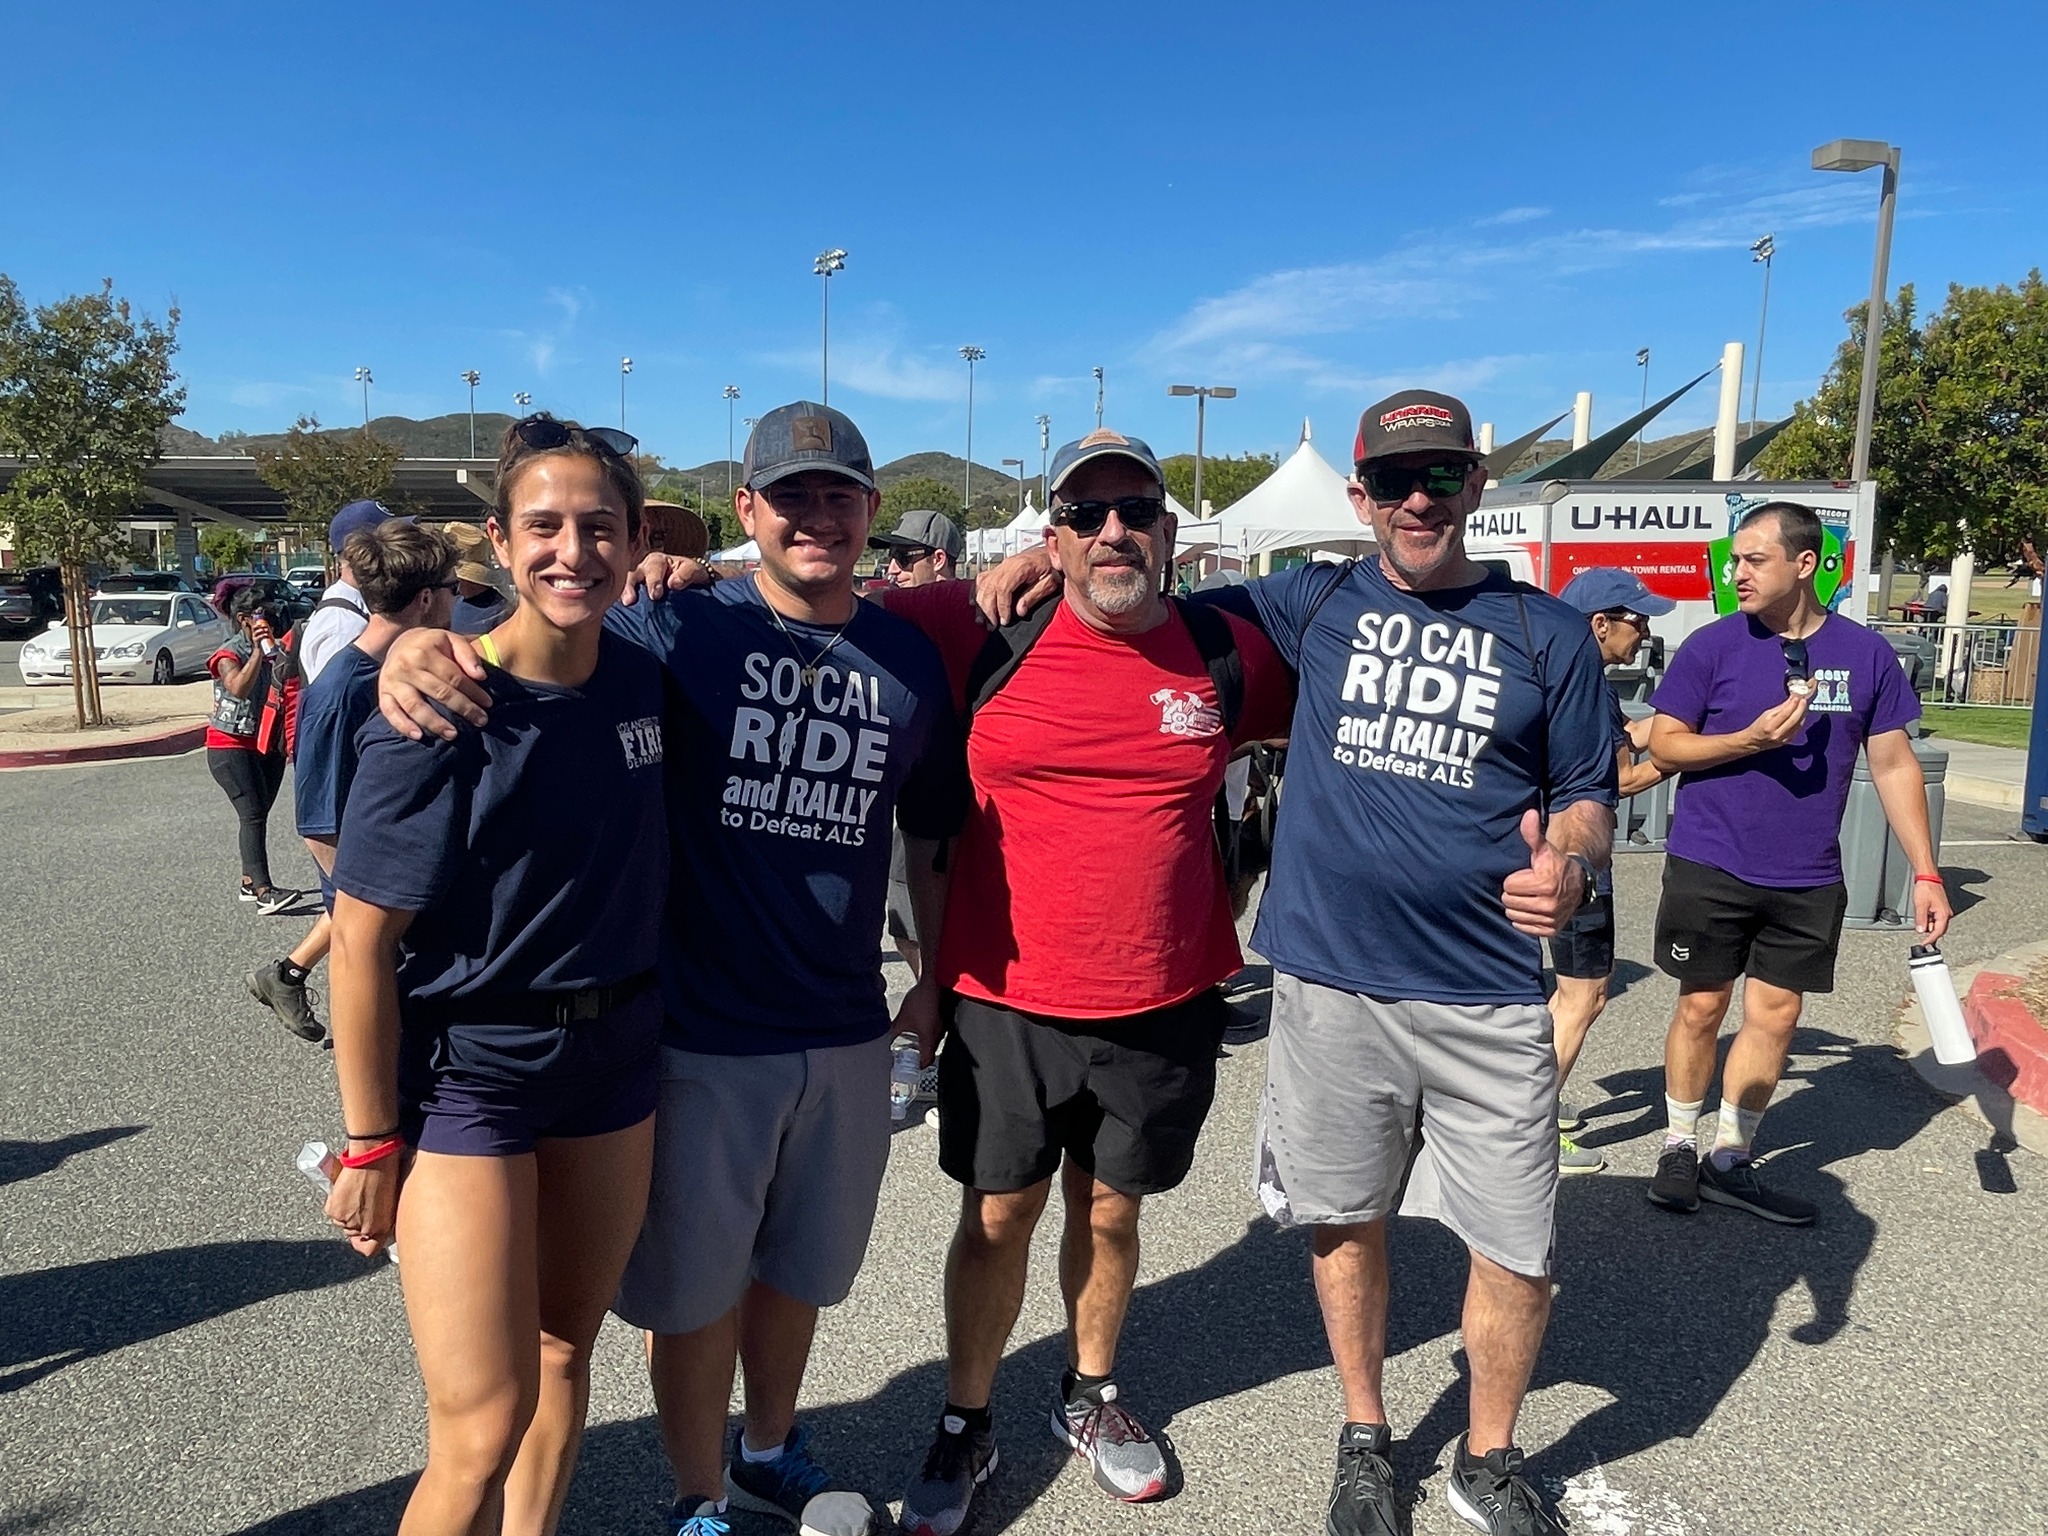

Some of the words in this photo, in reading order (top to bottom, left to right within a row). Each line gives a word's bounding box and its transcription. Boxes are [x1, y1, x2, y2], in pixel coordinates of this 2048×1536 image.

[1469, 512, 1527, 537] -HAUL
[1571, 505, 1712, 530] U-HAUL
[1815, 508, 1848, 518] OREGON
[1659, 565, 1697, 573] RENTALS
[1352, 612, 1412, 657] SO
[1420, 622, 1502, 677] CAL
[740, 652, 801, 706] SO
[812, 665, 890, 726] CAL
[1336, 713, 1389, 750] and
[1389, 716, 1489, 769] RALLY
[1332, 745, 1355, 765] to
[1358, 748, 1427, 780] Defeat
[1429, 765, 1474, 789] ALS
[722, 773, 782, 812] and
[785, 777, 878, 826] RALLY
[720, 807, 744, 828] to
[749, 811, 822, 841] Defeat
[825, 825, 866, 847] ALS
